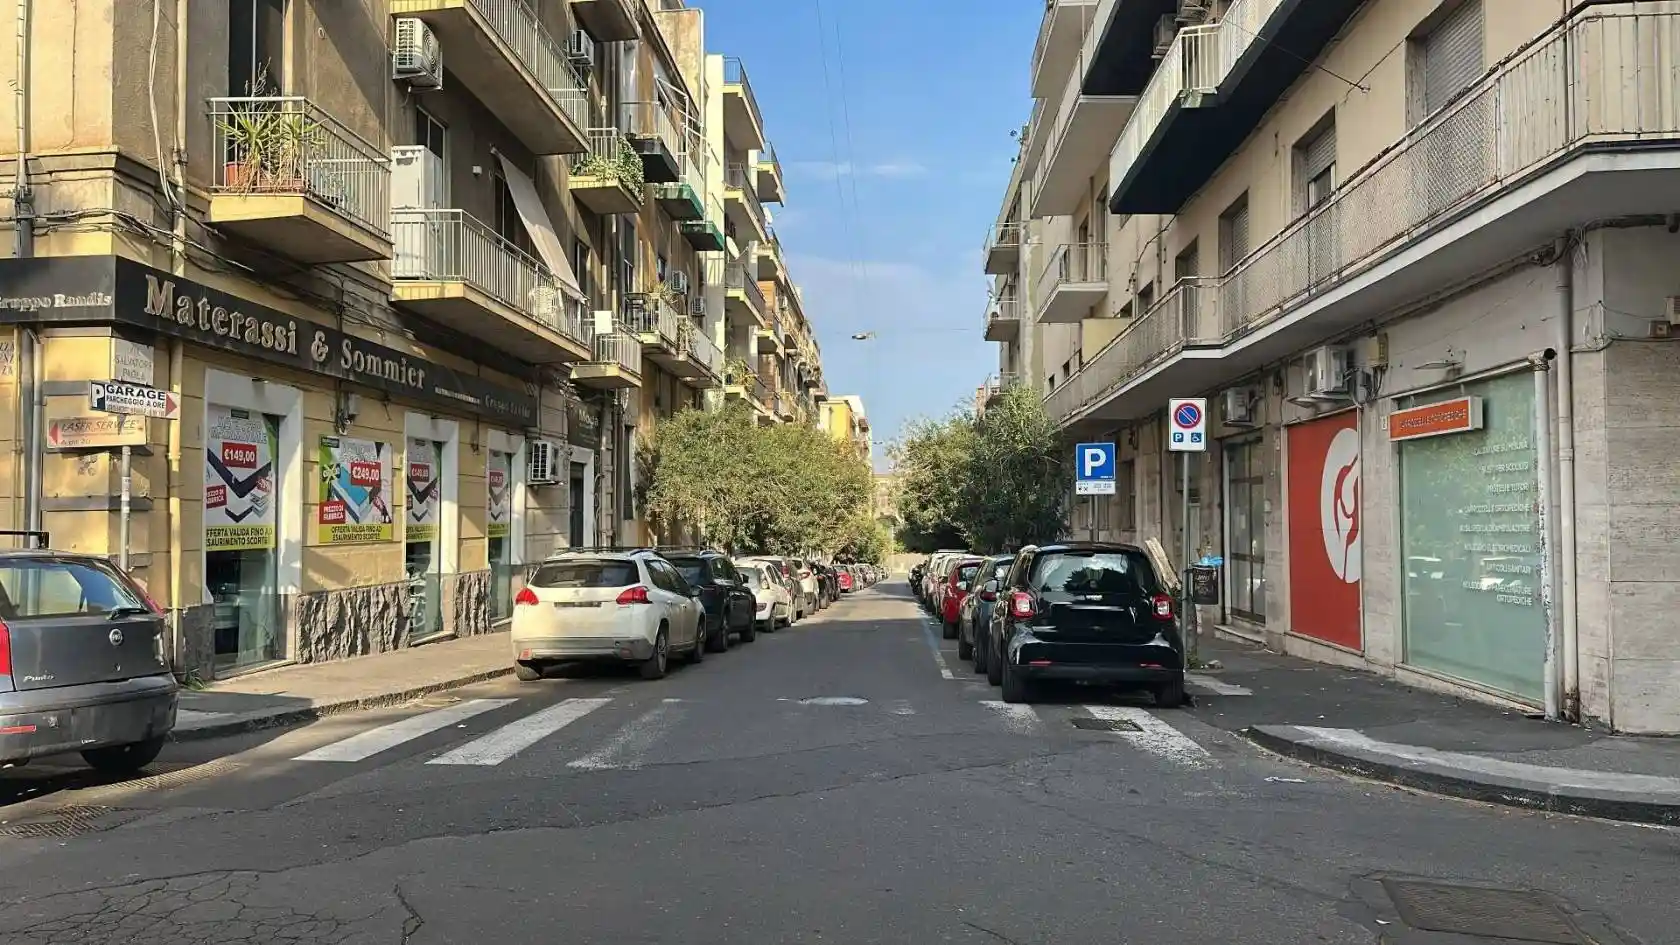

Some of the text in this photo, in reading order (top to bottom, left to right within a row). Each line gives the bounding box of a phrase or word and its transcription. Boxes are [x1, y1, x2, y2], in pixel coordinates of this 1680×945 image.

[145, 274, 425, 390] Materassi & Sommier
[92, 384, 165, 408] P GARAGE
[153, 401, 165, 409] ORE
[61, 421, 93, 433] LASER
[1175, 434, 1182, 442] P
[224, 448, 256, 464] €149,00
[1085, 448, 1106, 476] P
[352, 467, 380, 483] €249,00
[229, 527, 249, 537] VALIDA
[250, 527, 264, 536] FINO
